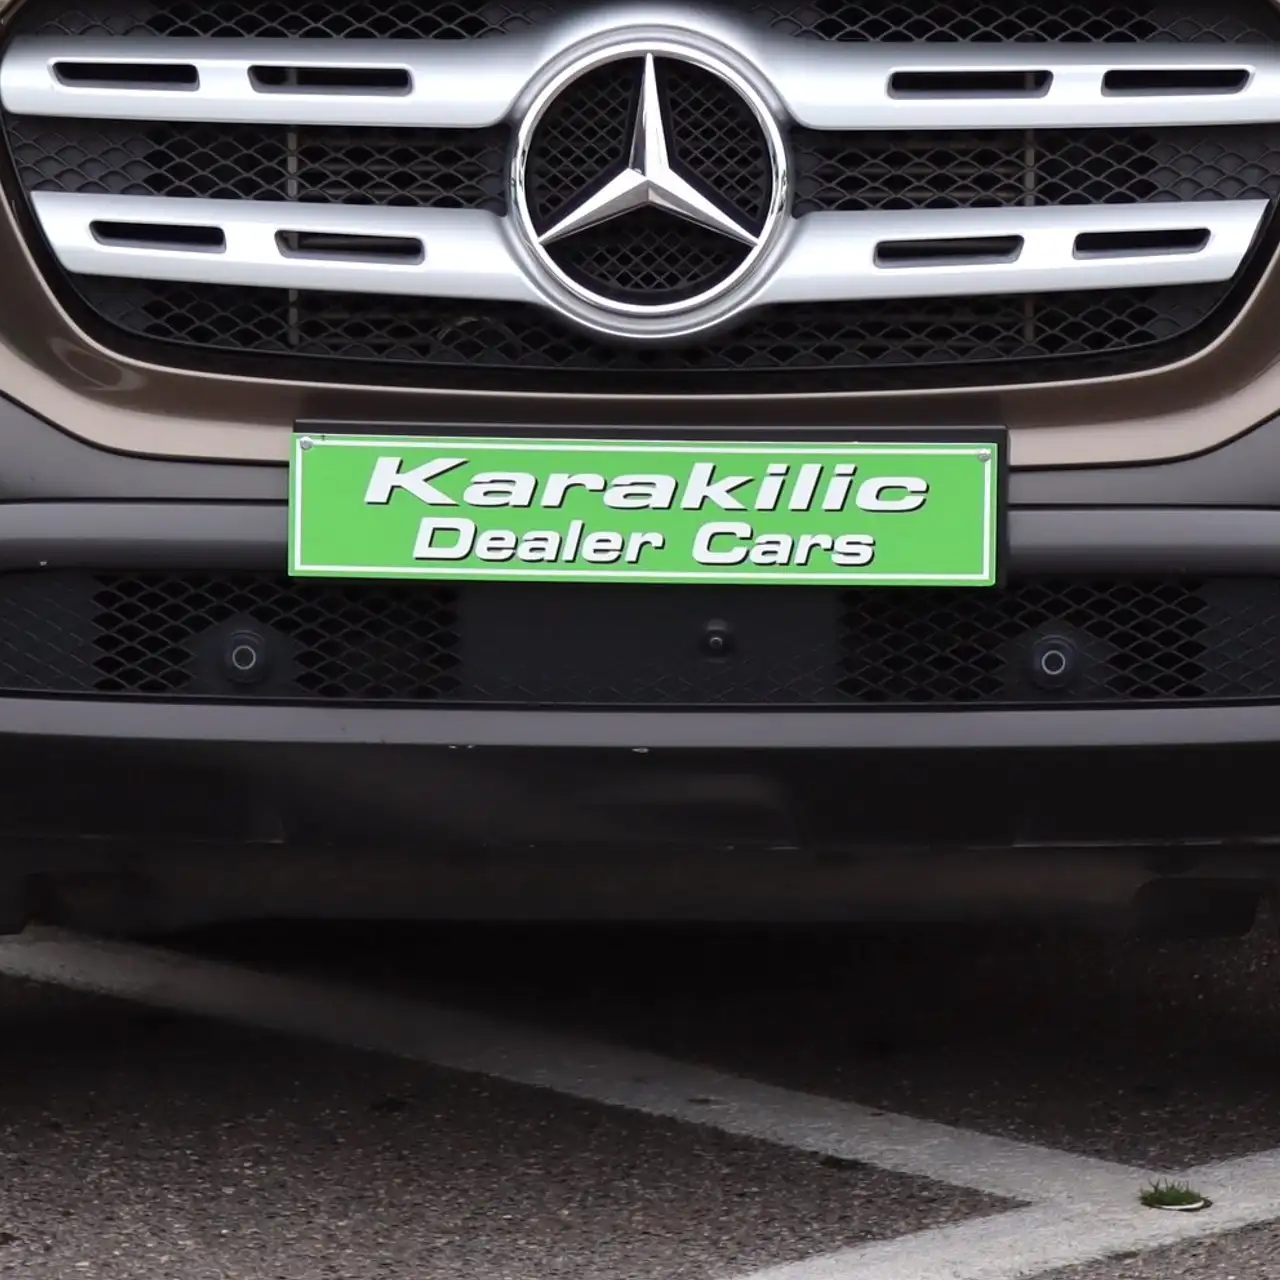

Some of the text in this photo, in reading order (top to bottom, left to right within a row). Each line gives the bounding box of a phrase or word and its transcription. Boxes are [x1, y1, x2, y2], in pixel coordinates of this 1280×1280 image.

[363, 455, 930, 515] Karakilic
[412, 516, 877, 567] Dealer Cars
